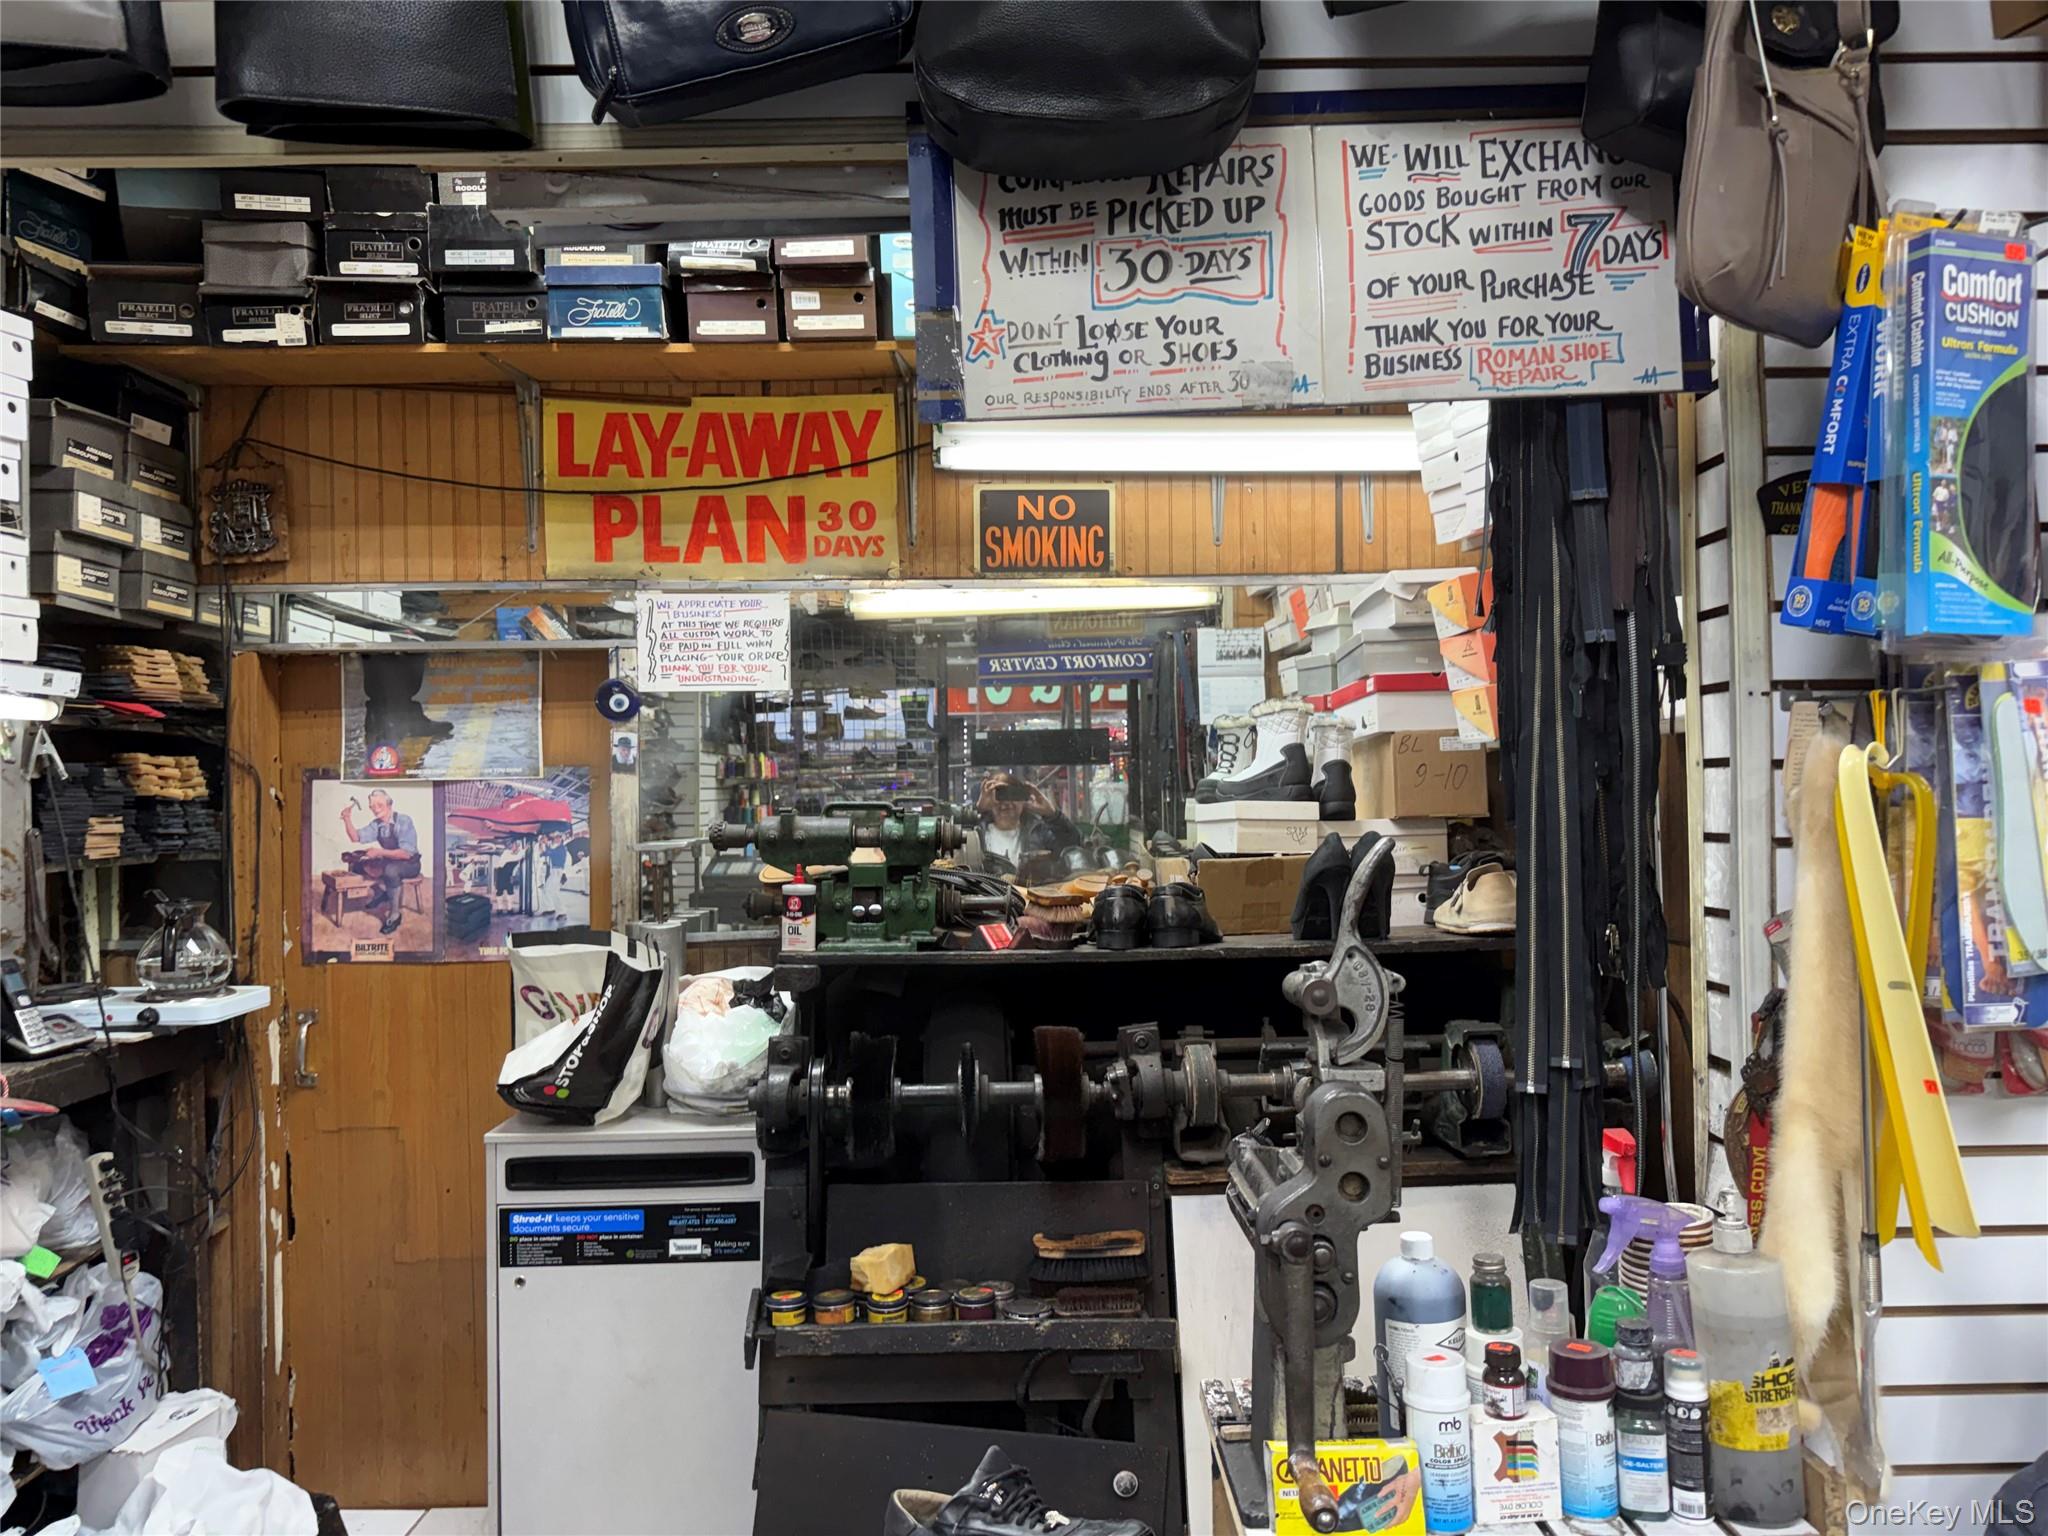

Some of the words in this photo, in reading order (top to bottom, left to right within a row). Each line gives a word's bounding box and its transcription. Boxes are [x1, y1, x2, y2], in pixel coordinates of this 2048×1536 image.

[1350, 143, 1391, 169] WE
[1404, 142, 1471, 173] WILL
[1358, 189, 1426, 217] GOODS
[1436, 183, 1527, 210] BOUGHT
[1537, 174, 1603, 200] FROM
[1610, 173, 1650, 189] OUR
[998, 203, 1058, 232] MUST
[1070, 201, 1100, 218] BE
[1106, 196, 1213, 235] PICKED
[1223, 196, 1266, 224] UP
[352, 243, 403, 252] FRATELLI
[1365, 212, 1462, 251] STOCK
[1469, 217, 1553, 245] WITHIN
[1565, 211, 1614, 273] 7
[1602, 227, 1663, 266] DAYS
[999, 243, 1089, 274] WITHIN
[1103, 247, 1173, 292] 30
[1184, 245, 1252, 276] DAYS
[1366, 275, 1400, 300] OF
[1407, 268, 1475, 296] YOUR
[1480, 268, 1596, 303] PURCHASE
[1910, 271, 1926, 318] Comfort
[1943, 263, 2022, 305] Comfort
[120, 303, 175, 314] FRATELLI
[346, 304, 395, 313] FRATELLI
[1945, 302, 2020, 328] CUSHION
[1155, 315, 1224, 339] YOUR
[1365, 317, 1445, 349] THANK
[1447, 318, 1487, 342] YOU
[1498, 314, 1545, 338] FOR
[1544, 310, 1614, 334] YOUR
[1839, 313, 1862, 372] EXTRA
[1910, 319, 1925, 368] Cushion
[1941, 336, 1974, 350] Ultron
[1977, 340, 2018, 355] Formula
[1013, 348, 1110, 382] CLOTHING
[1118, 349, 1153, 366] OR
[1159, 338, 1239, 366] SHOES
[1364, 348, 1463, 379] BUSINESS
[1477, 344, 1556, 373] ROMAN
[1560, 341, 1613, 364] SHOE
[1873, 318, 1891, 400] WORK
[984, 392, 1018, 407] OUR
[1023, 385, 1132, 408] RESPONSIBILITY
[1138, 383, 1172, 399] ENDS
[1179, 379, 1225, 396] AFTER
[1225, 369, 1251, 393] 30
[1491, 365, 1578, 386] REPAIR
[1822, 375, 1849, 455] COMFORT
[556, 408, 884, 479] LAY-AWAY
[1016, 494, 1076, 521] NO
[592, 494, 808, 565] PLAN
[817, 500, 878, 532] 30
[813, 533, 885, 558] DAYS
[983, 524, 1106, 569] SMOKING
[656, 600, 672, 610] WE
[677, 599, 736, 609] APPRECIATE
[738, 599, 763, 608] YOUR
[672, 610, 723, 619] BUSINESS
[660, 621, 675, 629] AT
[677, 620, 697, 629] THIS
[699, 620, 722, 630] TIME
[724, 620, 740, 629] WE
[743, 618, 784, 629] REQUIRE
[660, 631, 680, 641] ALL
[682, 630, 720, 640] CUSTOM
[723, 629, 758, 638] WORK
[761, 630, 773, 638] TO
[659, 642, 673, 651] BE
[678, 642, 699, 651] PAID
[717, 640, 743, 650] FULL
[715, 653, 745, 662] YOUR
[660, 664, 693, 673] THANK
[697, 664, 715, 673] YOU
[718, 664, 739, 673] FOR
[742, 664, 772, 673] YOUR
[1397, 734, 1424, 754] BL
[1414, 763, 1469, 790] 9-10
[787, 925, 802, 936] OIL
[355, 943, 389, 951] BILTRITE
[1966, 960, 1976, 1002] Plantillas
[512, 1224, 561, 1233] documents
[562, 1224, 593, 1232] secure.
[555, 1213, 581, 1224] keeps
[582, 1214, 602, 1224] your
[603, 1211, 640, 1221] sensitive
[714, 1240, 737, 1248] Making
[1751, 1367, 1796, 1389] SHOE
[74, 1396, 137, 1434] Thank
[1438, 1416, 1462, 1432] mb
[1623, 1459, 1664, 1469] DE-SALTER
